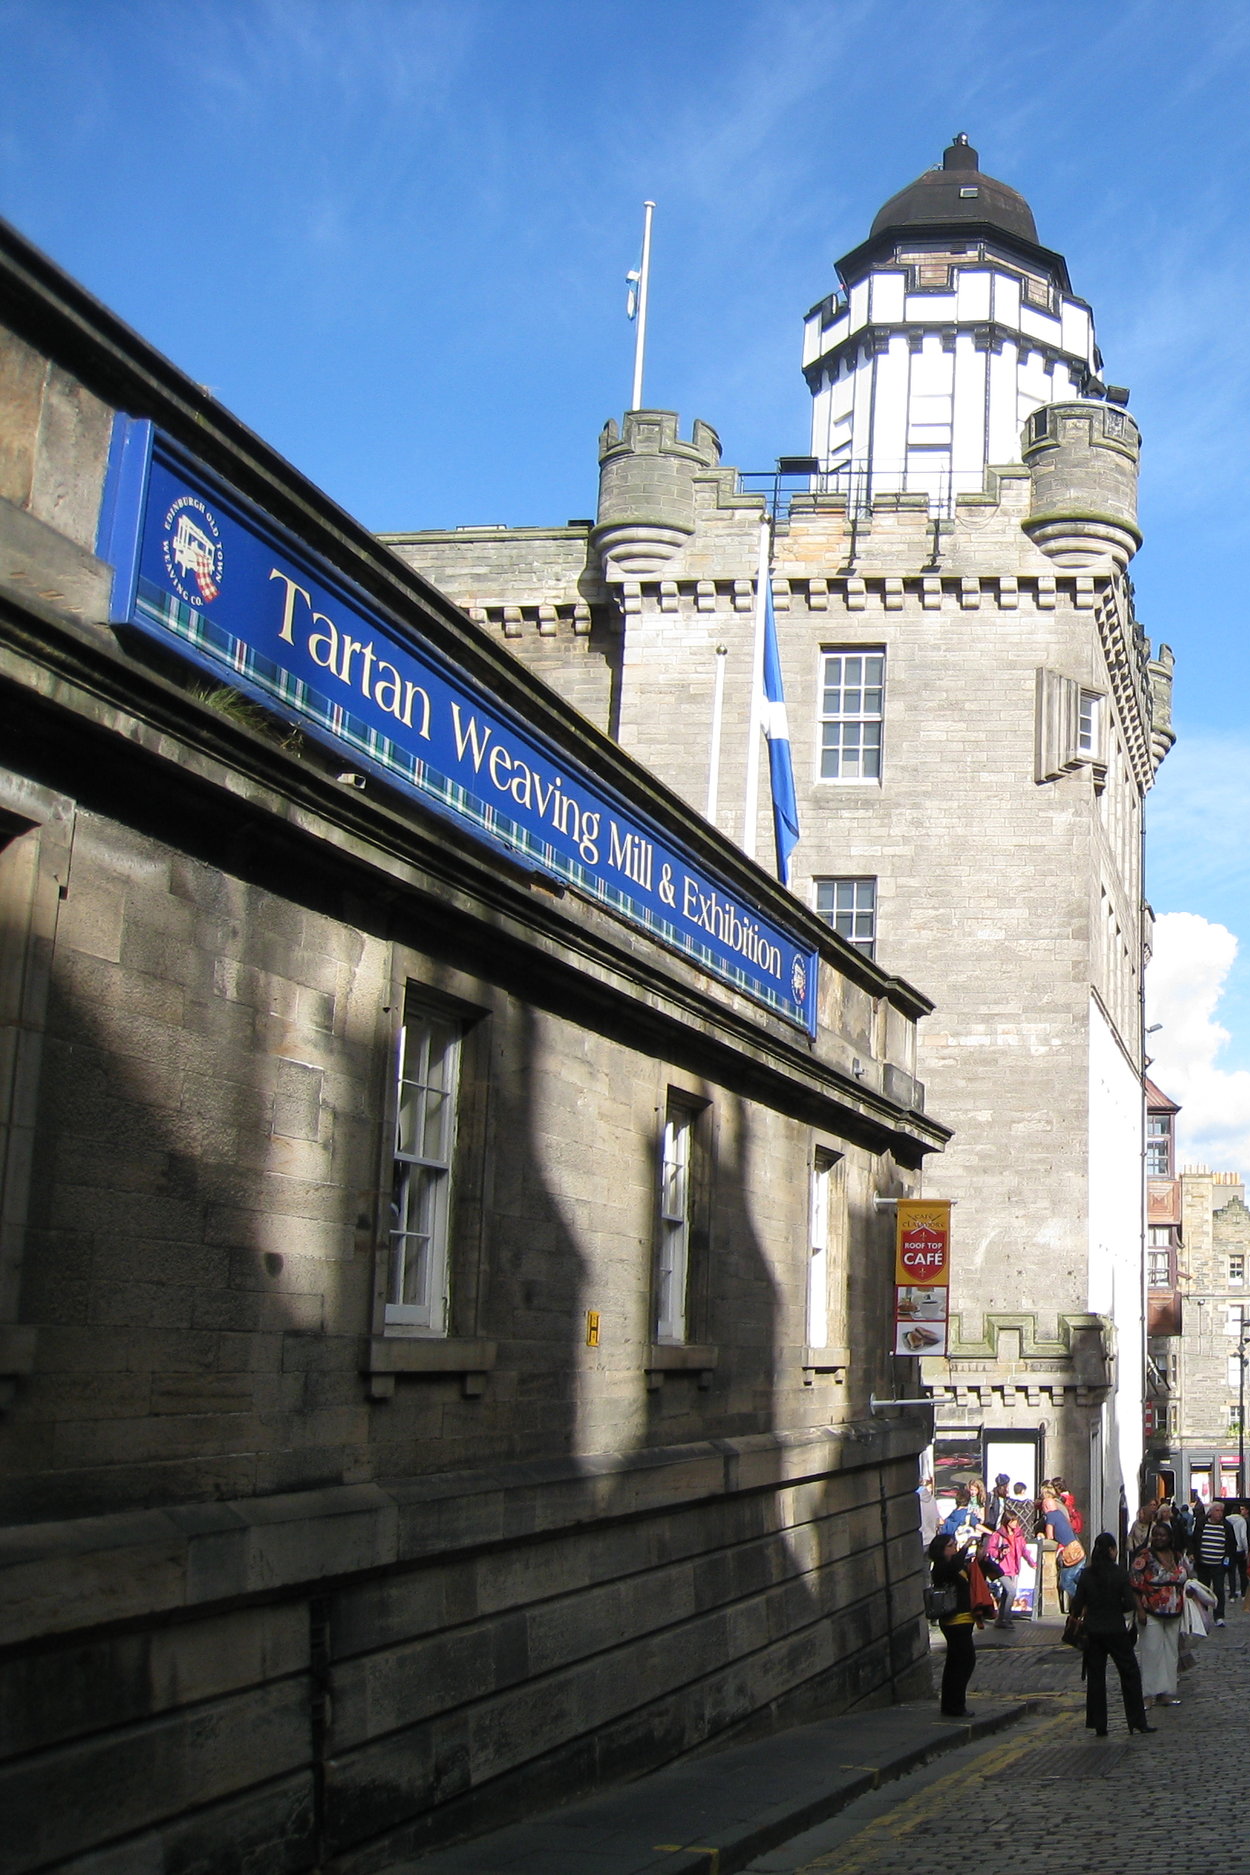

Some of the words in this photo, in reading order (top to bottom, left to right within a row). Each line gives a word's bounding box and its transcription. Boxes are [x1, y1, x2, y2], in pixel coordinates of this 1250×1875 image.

[162, 540, 189, 601] WEAVING
[190, 596, 204, 606] CO.
[164, 496, 206, 531] EDINBURGH
[206, 512, 220, 538] OLD
[215, 541, 224, 584] TOWN
[269, 567, 432, 742] Tartan
[451, 701, 600, 865] Weaving
[608, 820, 653, 893] Mill
[658, 863, 676, 909] &
[682, 875, 782, 980] Exhibition
[903, 1250, 943, 1266] CAFÉ
[904, 1242, 925, 1250] ROOF
[927, 1242, 943, 1250] TOP
